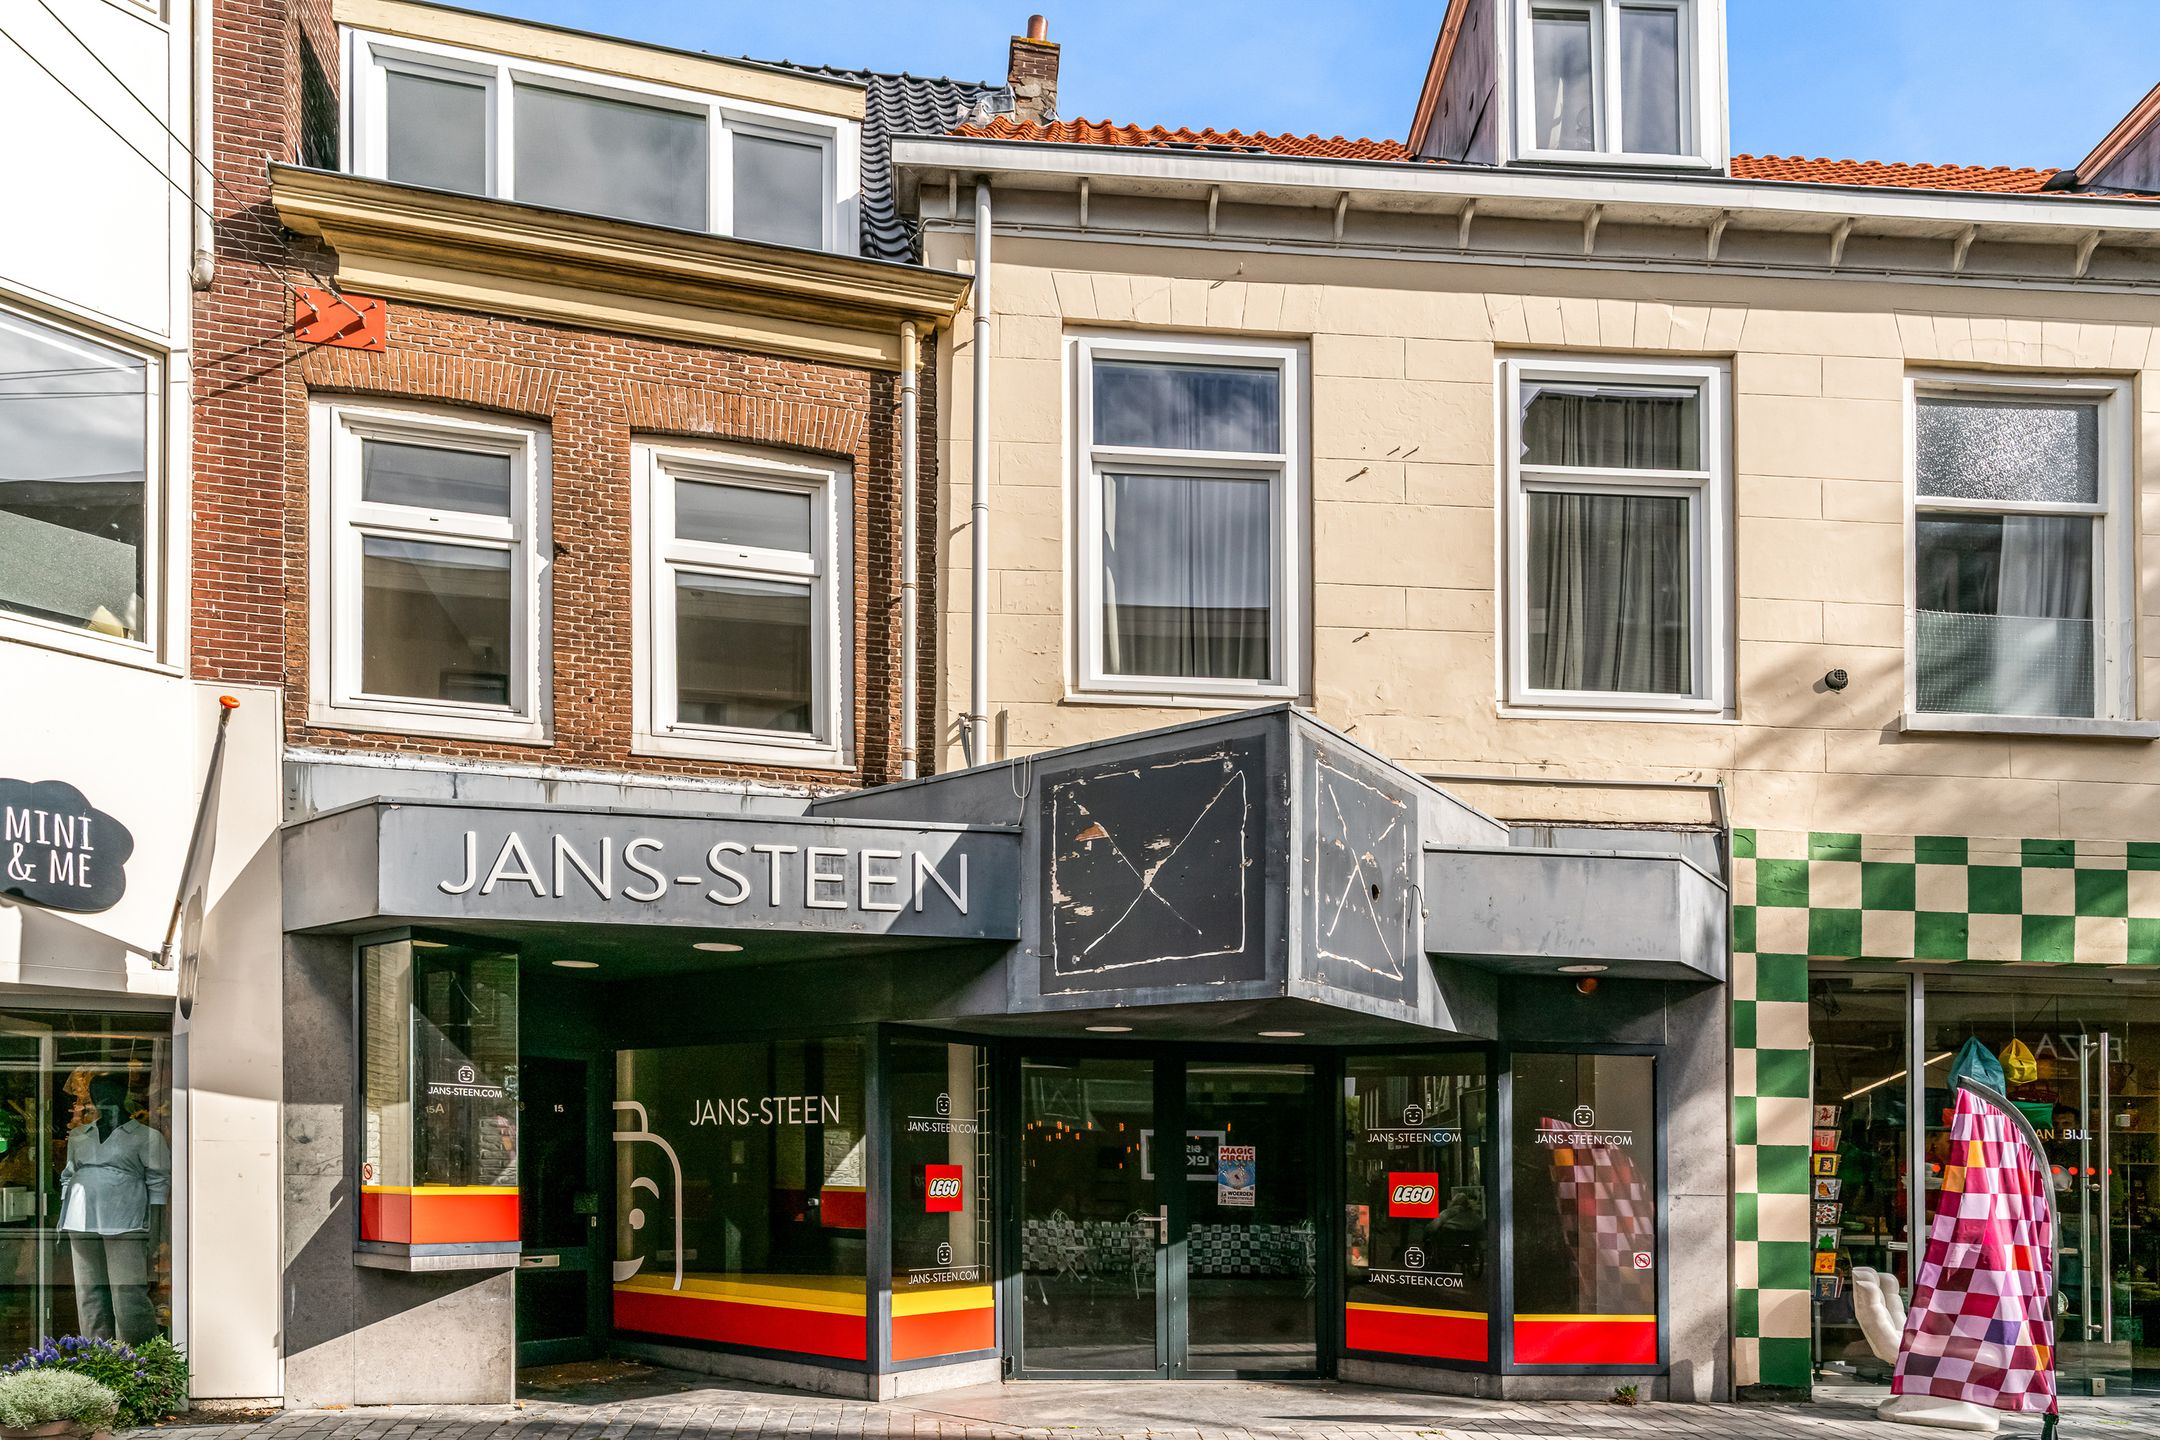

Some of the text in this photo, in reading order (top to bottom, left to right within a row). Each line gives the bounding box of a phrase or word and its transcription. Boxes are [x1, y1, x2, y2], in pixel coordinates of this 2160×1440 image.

[5, 806, 94, 850] MINI
[8, 842, 93, 888] & ME
[438, 831, 969, 915] JANS-STEEN
[427, 1086, 503, 1098] JANS-STEEN.COM
[553, 1104, 565, 1113] 15
[689, 1095, 840, 1127] JANS-STEEN
[907, 1120, 978, 1134] JANS-STEEN.COM
[2035, 1128, 2093, 1140] AN BIJL
[1367, 1132, 1462, 1144] JANS-STEEN.COM
[1534, 1133, 1633, 1146] JANS-STEEN.COM
[1220, 1147, 1253, 1155] MAGIC
[927, 1177, 961, 1198] LEGO
[1393, 1186, 1435, 1204] LEGO
[909, 1269, 980, 1285] JANS-STEEN.COM
[1369, 1273, 1464, 1288] JANS-STEEN.COM
